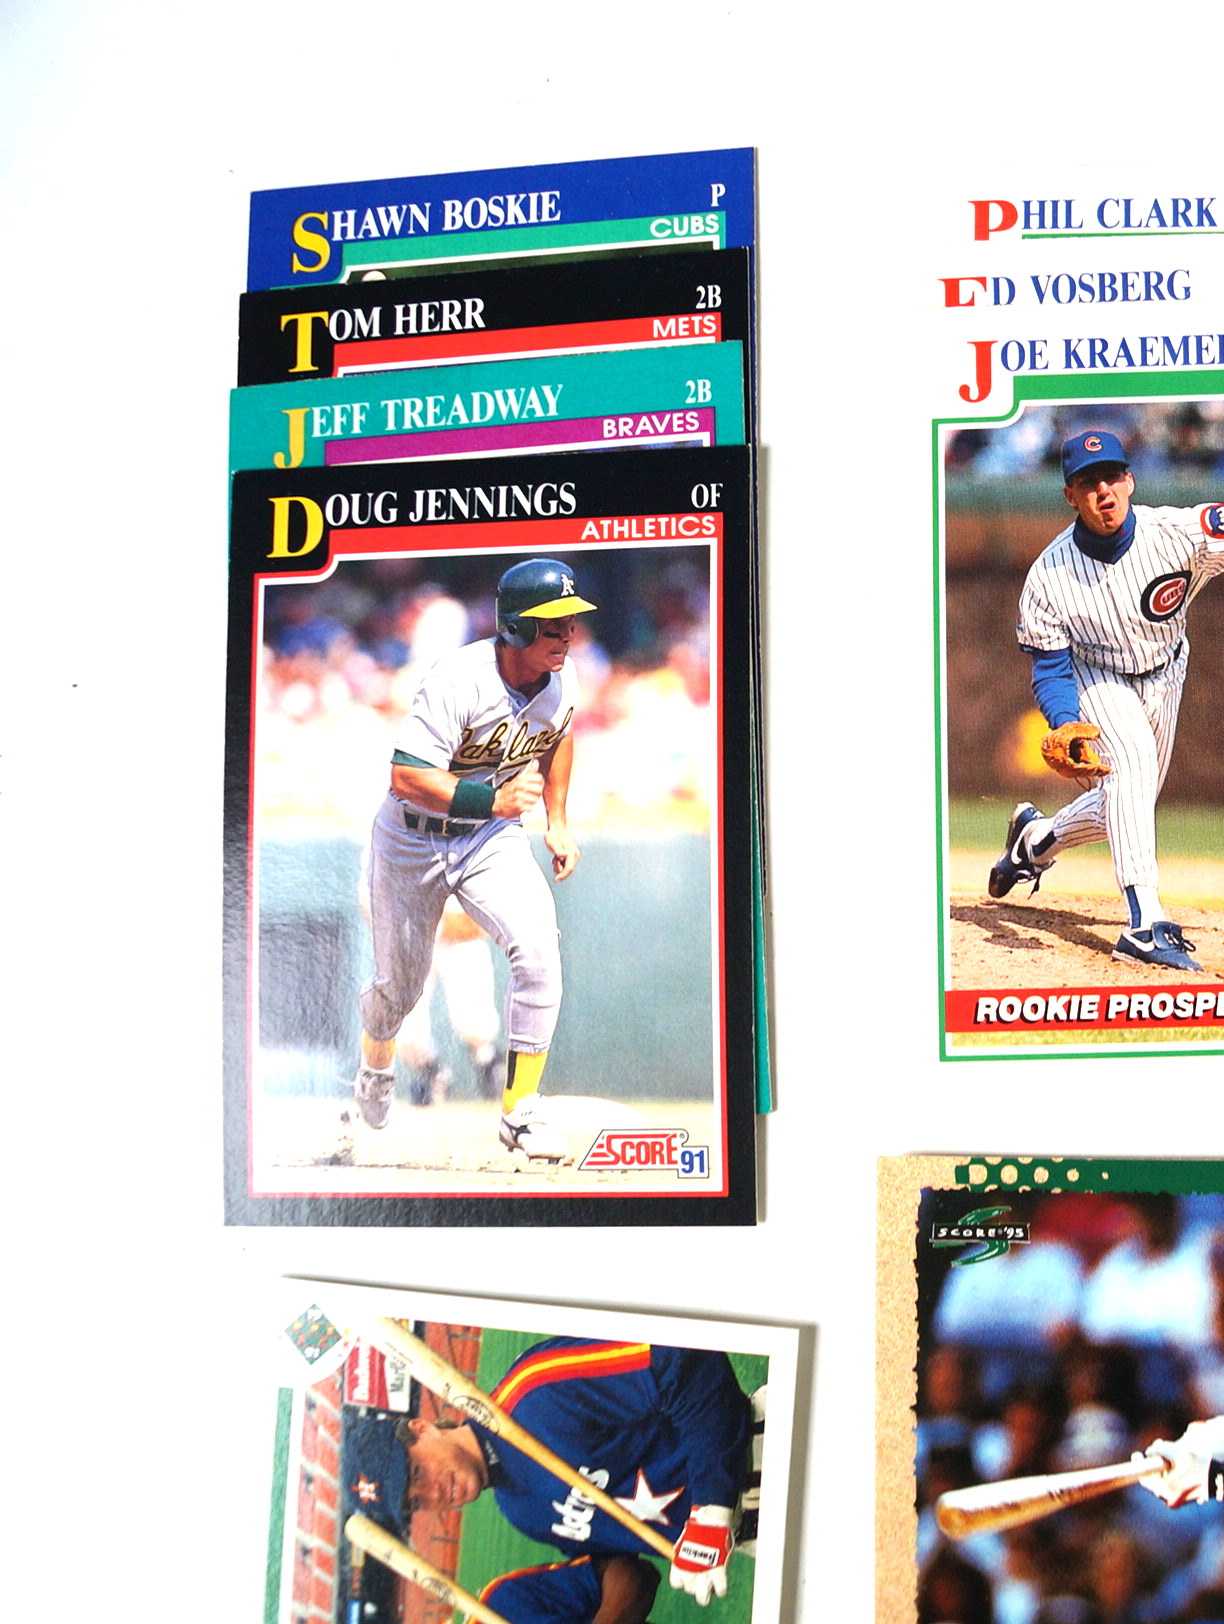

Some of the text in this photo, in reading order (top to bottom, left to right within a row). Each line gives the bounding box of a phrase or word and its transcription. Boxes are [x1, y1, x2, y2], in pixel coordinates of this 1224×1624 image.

[710, 183, 726, 207] P
[292, 191, 561, 274] SHAWN BOSKIE
[650, 214, 719, 238] CUBS
[968, 198, 1218, 241] PHIL CLARK
[695, 284, 722, 309] 2B
[1030, 269, 1191, 304] VOSBERG
[280, 297, 486, 373] TOM HERR
[653, 315, 717, 338] METS
[958, 339, 1049, 403] JOE
[685, 379, 712, 404] 2B
[273, 384, 563, 469] JEFF TREADWAY
[603, 412, 700, 438] BRAVES
[1084, 436, 1102, 452] C
[691, 483, 723, 509] OF
[266, 482, 577, 558] DOUG JENNINGS
[580, 515, 716, 540] ATHLETICS
[974, 994, 1101, 1024] ROOKIE
[585, 1133, 705, 1174] SCORE 91
[938, 1227, 996, 1238] SCORE
